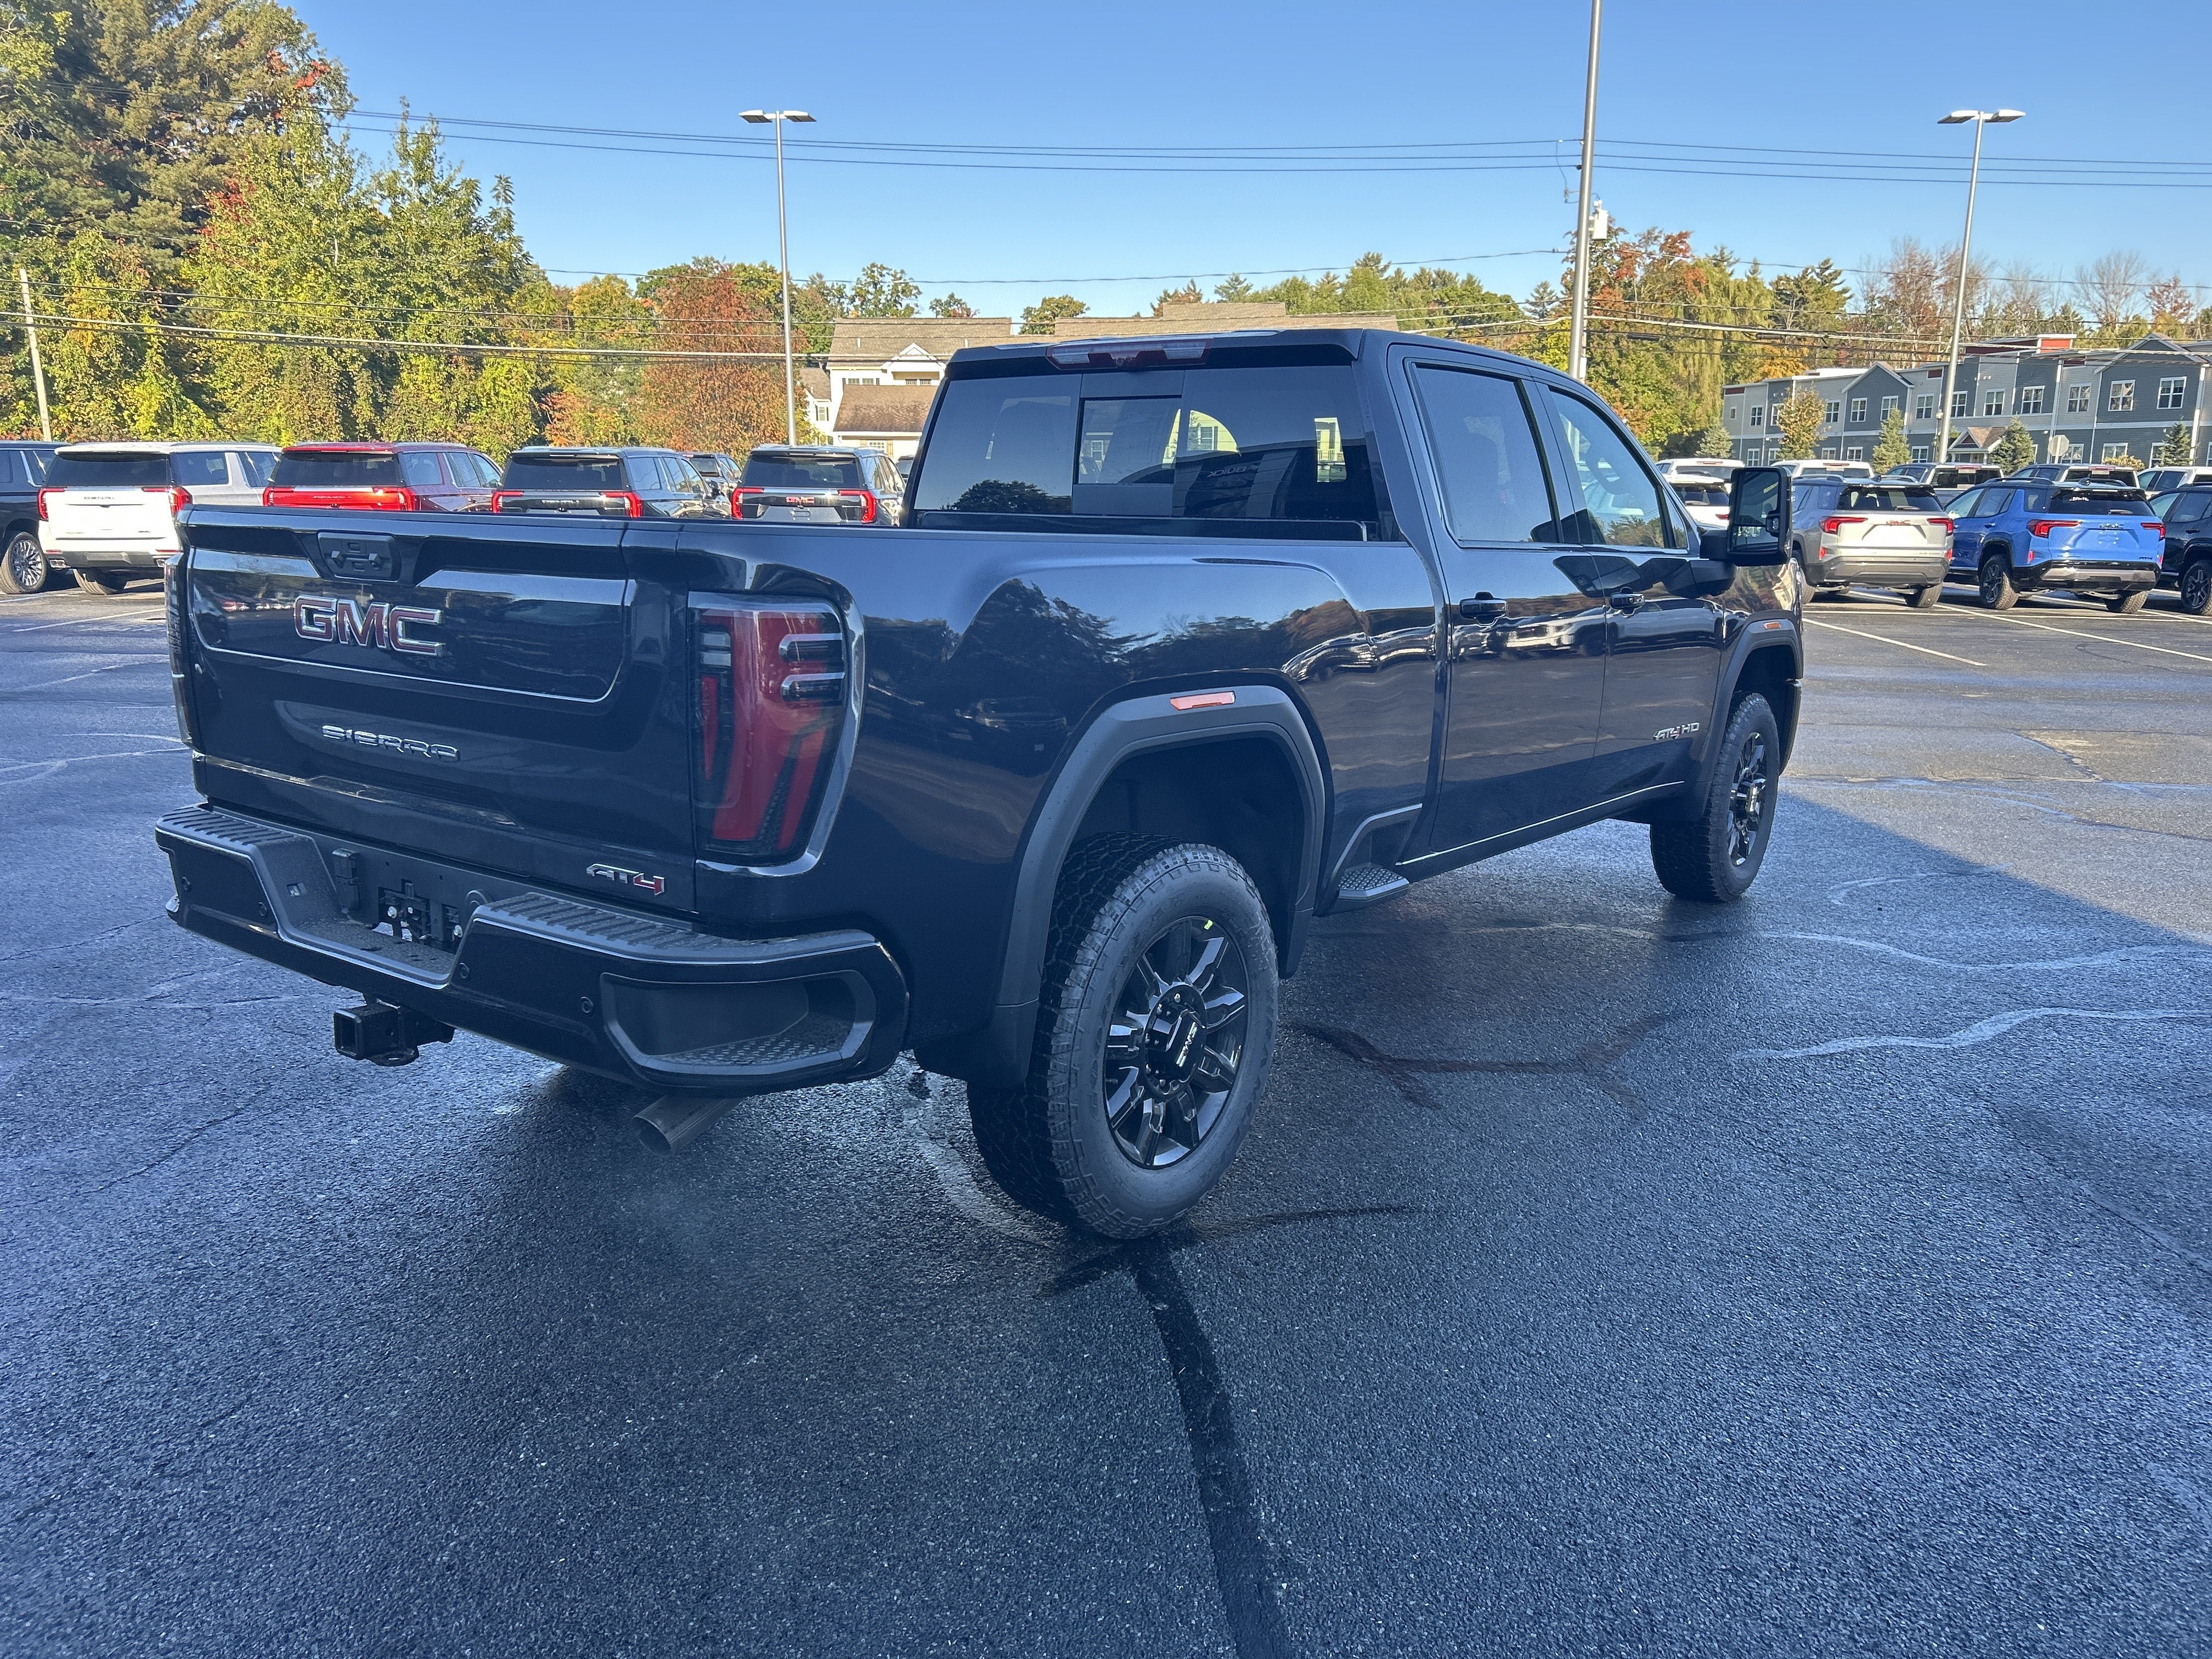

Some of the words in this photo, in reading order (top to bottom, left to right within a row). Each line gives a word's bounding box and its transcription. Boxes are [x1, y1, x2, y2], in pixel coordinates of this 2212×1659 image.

[295, 594, 445, 657] GMC
[322, 725, 460, 762] SIERRA
[1653, 726, 1681, 741] AT4
[1681, 722, 1700, 734] HD
[586, 863, 665, 895] AT4
[1176, 1022, 1198, 1068] GMC
